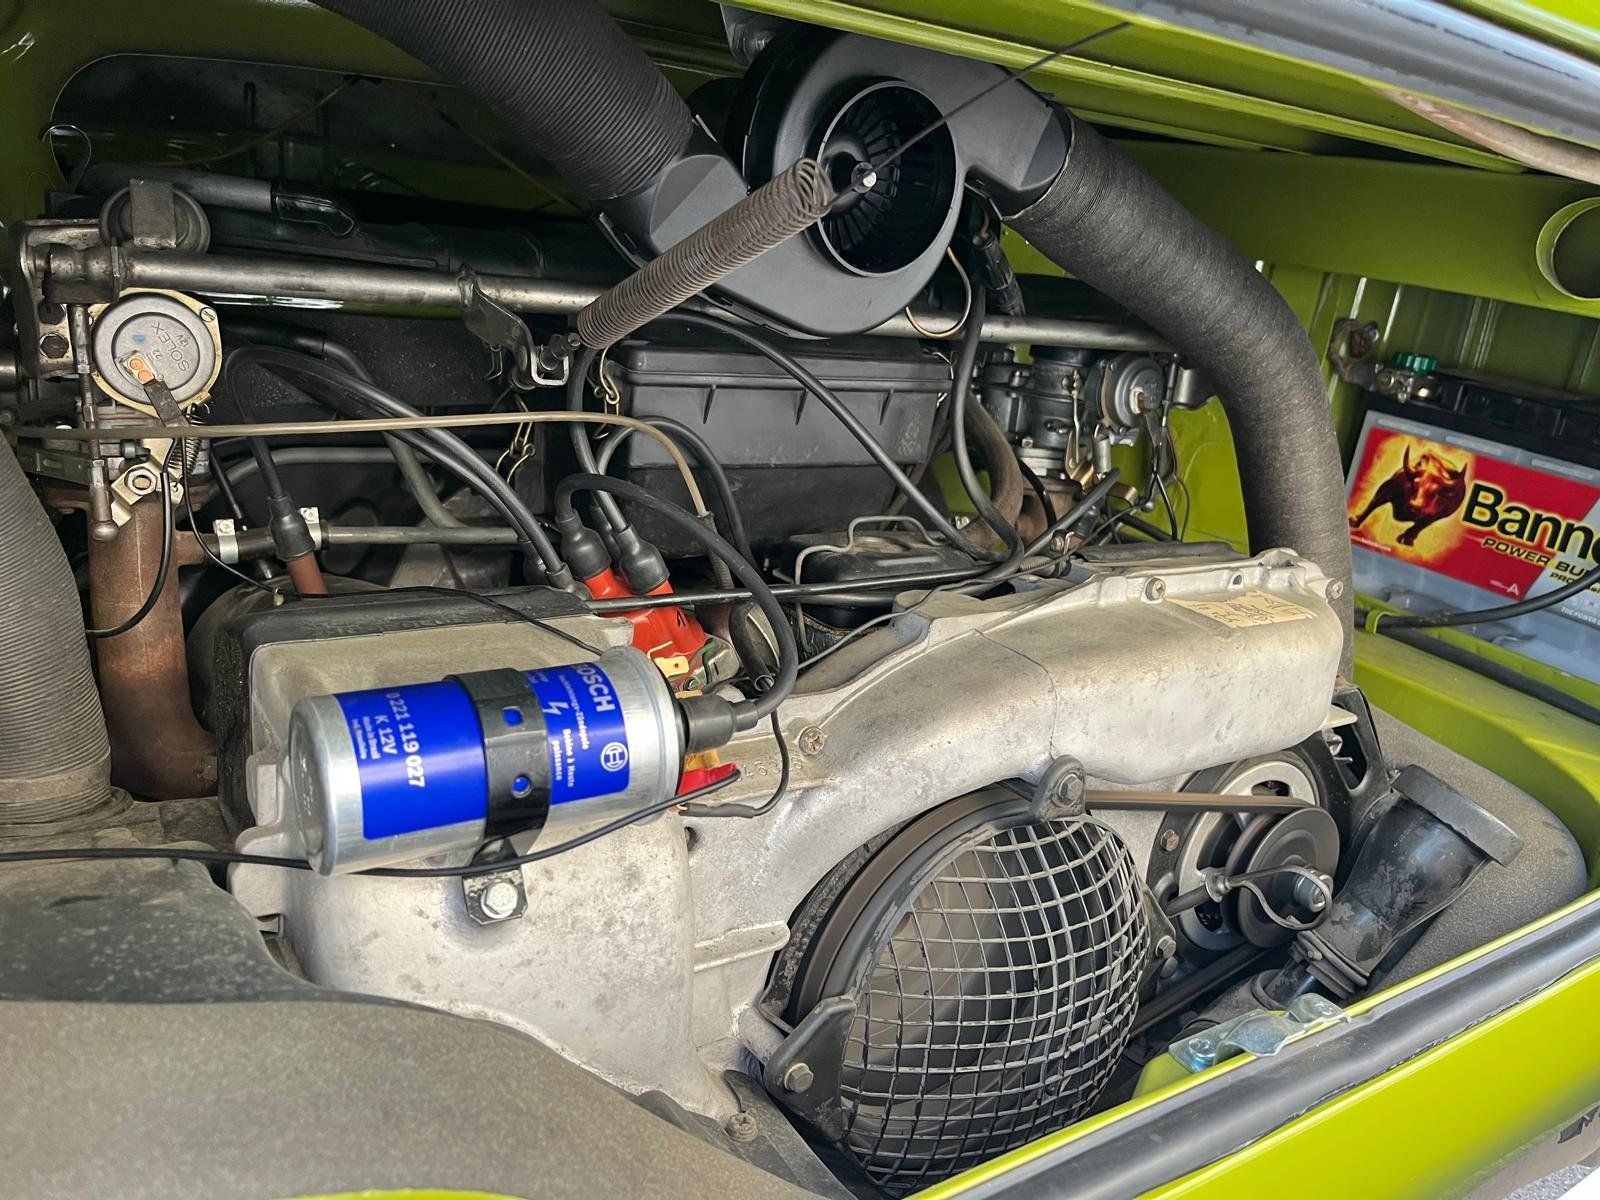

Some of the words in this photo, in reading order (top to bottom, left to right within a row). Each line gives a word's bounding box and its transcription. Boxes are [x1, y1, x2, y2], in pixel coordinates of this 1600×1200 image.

[151, 321, 190, 371] SOLEX
[1482, 538, 1551, 566] POWER
[573, 664, 616, 712] OSCH
[374, 715, 390, 724] K
[389, 699, 411, 720] 221
[378, 728, 398, 754] 12V
[398, 723, 419, 754] 119
[405, 755, 425, 787] 027
